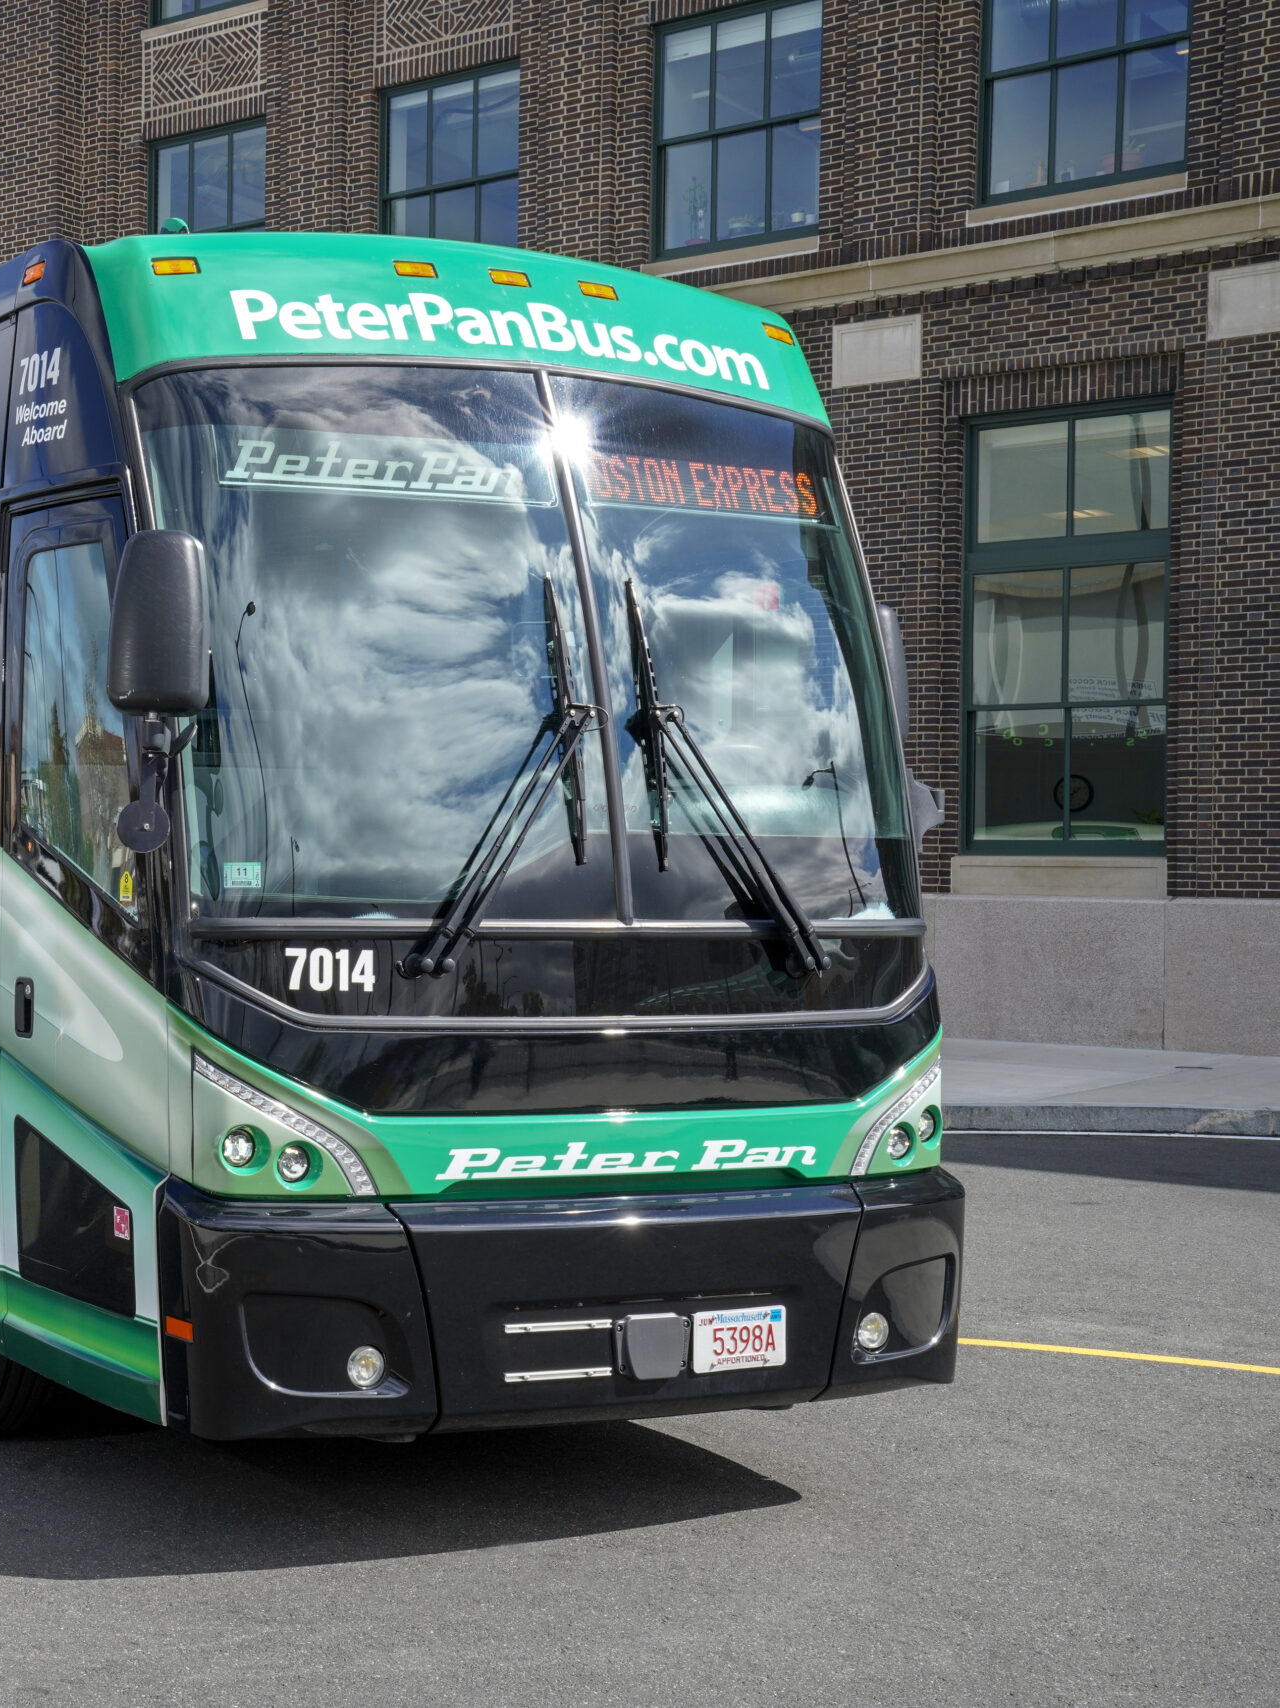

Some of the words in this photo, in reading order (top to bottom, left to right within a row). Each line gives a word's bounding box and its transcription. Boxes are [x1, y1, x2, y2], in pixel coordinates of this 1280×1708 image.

[229, 289, 770, 391] PeterPanBus.com
[19, 347, 61, 395] 7014
[15, 399, 67, 425] Welcome
[21, 419, 67, 447] Aboard
[688, 461, 819, 515] EXPRESS
[285, 947, 375, 992] 7014
[435, 1142, 680, 1181] Peter
[691, 1139, 817, 1171] Pan
[716, 1312, 766, 1324] Massachusetts
[713, 1323, 776, 1356] 5398A
[717, 1354, 766, 1366] APPORTIONED
